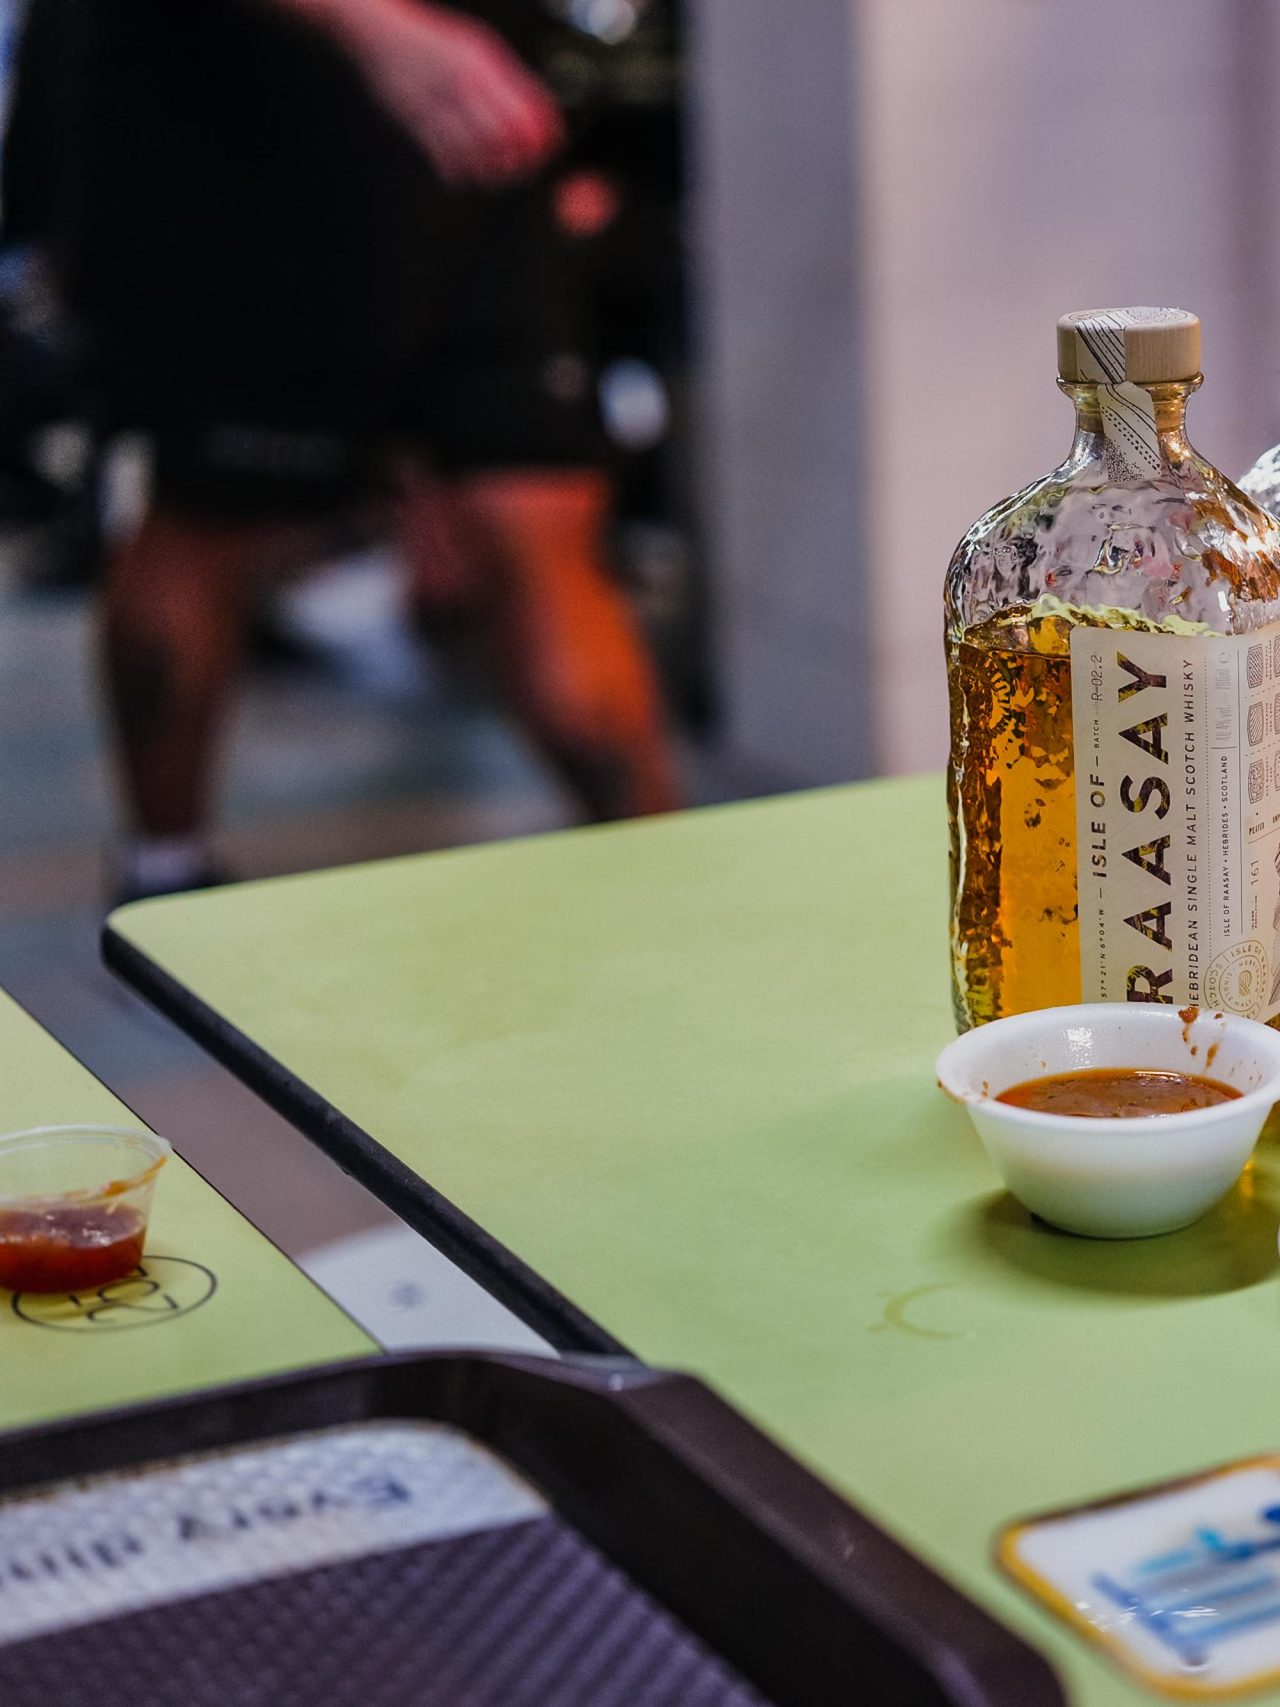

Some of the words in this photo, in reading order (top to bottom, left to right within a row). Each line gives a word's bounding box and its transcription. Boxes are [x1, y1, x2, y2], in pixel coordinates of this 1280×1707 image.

[1183, 658, 1195, 723] WHISKY
[1184, 731, 1196, 796] SCOTCH
[1220, 755, 1230, 802] SCOTLAND
[1090, 773, 1106, 808] OF
[1117, 650, 1173, 1005] RAASAY
[1185, 804, 1197, 846] MALT
[1221, 812, 1230, 856] HEBRIDES
[1091, 821, 1108, 878] ISLE
[1187, 853, 1198, 912] SINGLE
[1222, 866, 1231, 901] RAASAY
[1250, 860, 1259, 886] 161
[1222, 904, 1231, 915] OF
[1223, 917, 1231, 937] ISLE
